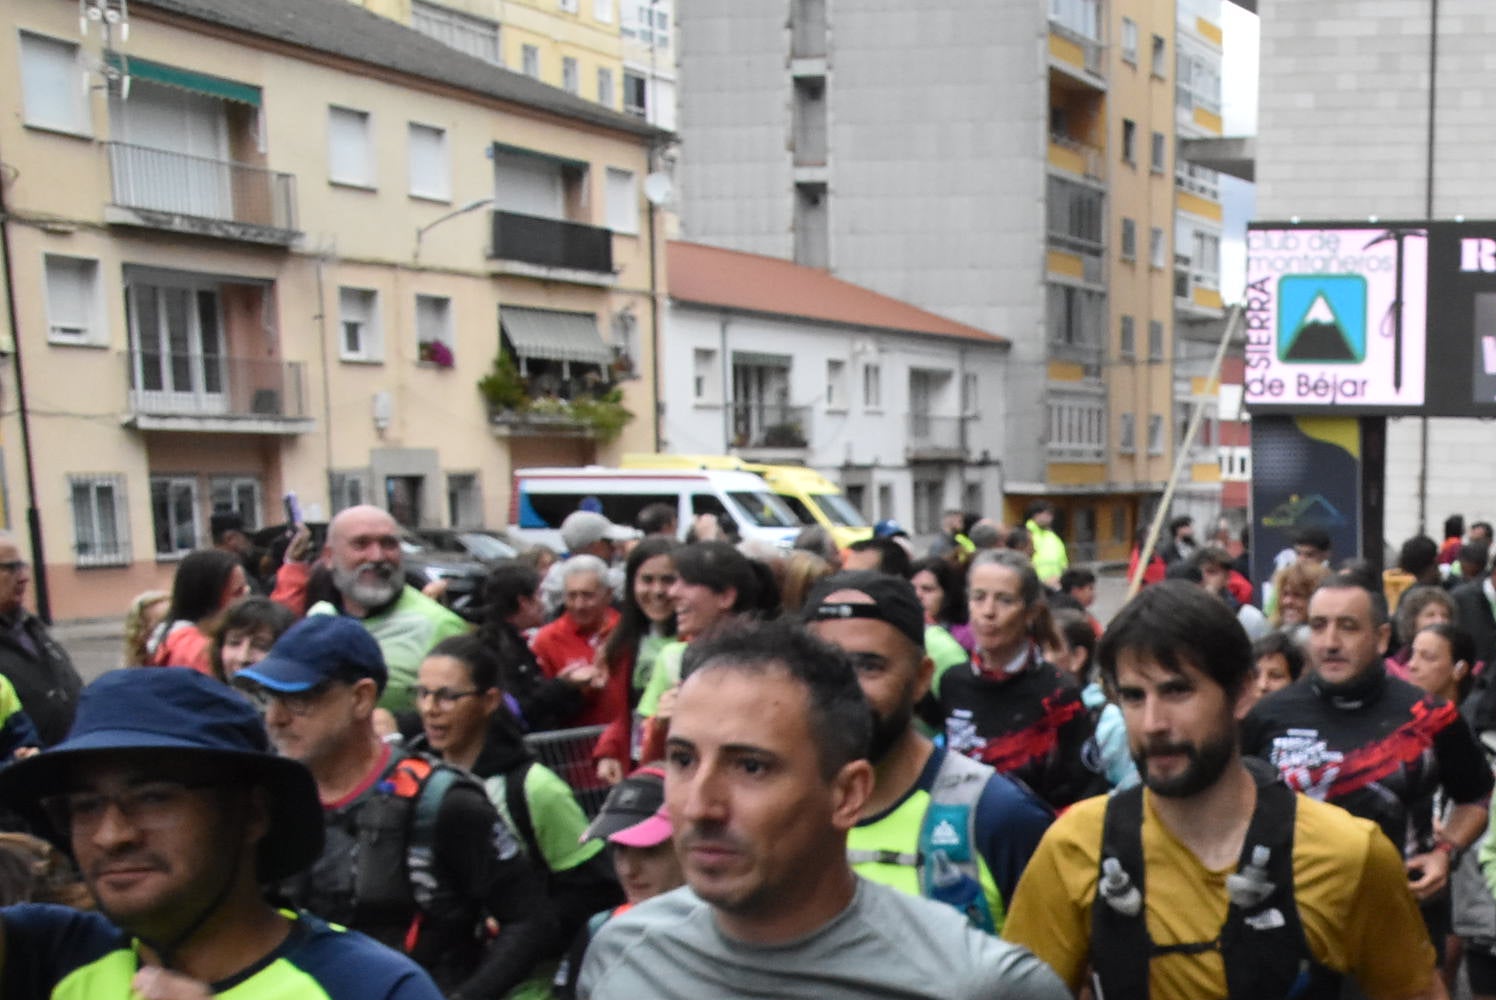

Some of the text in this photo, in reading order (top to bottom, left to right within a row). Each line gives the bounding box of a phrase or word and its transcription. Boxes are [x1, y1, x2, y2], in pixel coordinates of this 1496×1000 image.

[1248, 230, 1341, 250] club de
[1248, 276, 1271, 370] SIERRA
[1246, 371, 1367, 405] de Béjar
